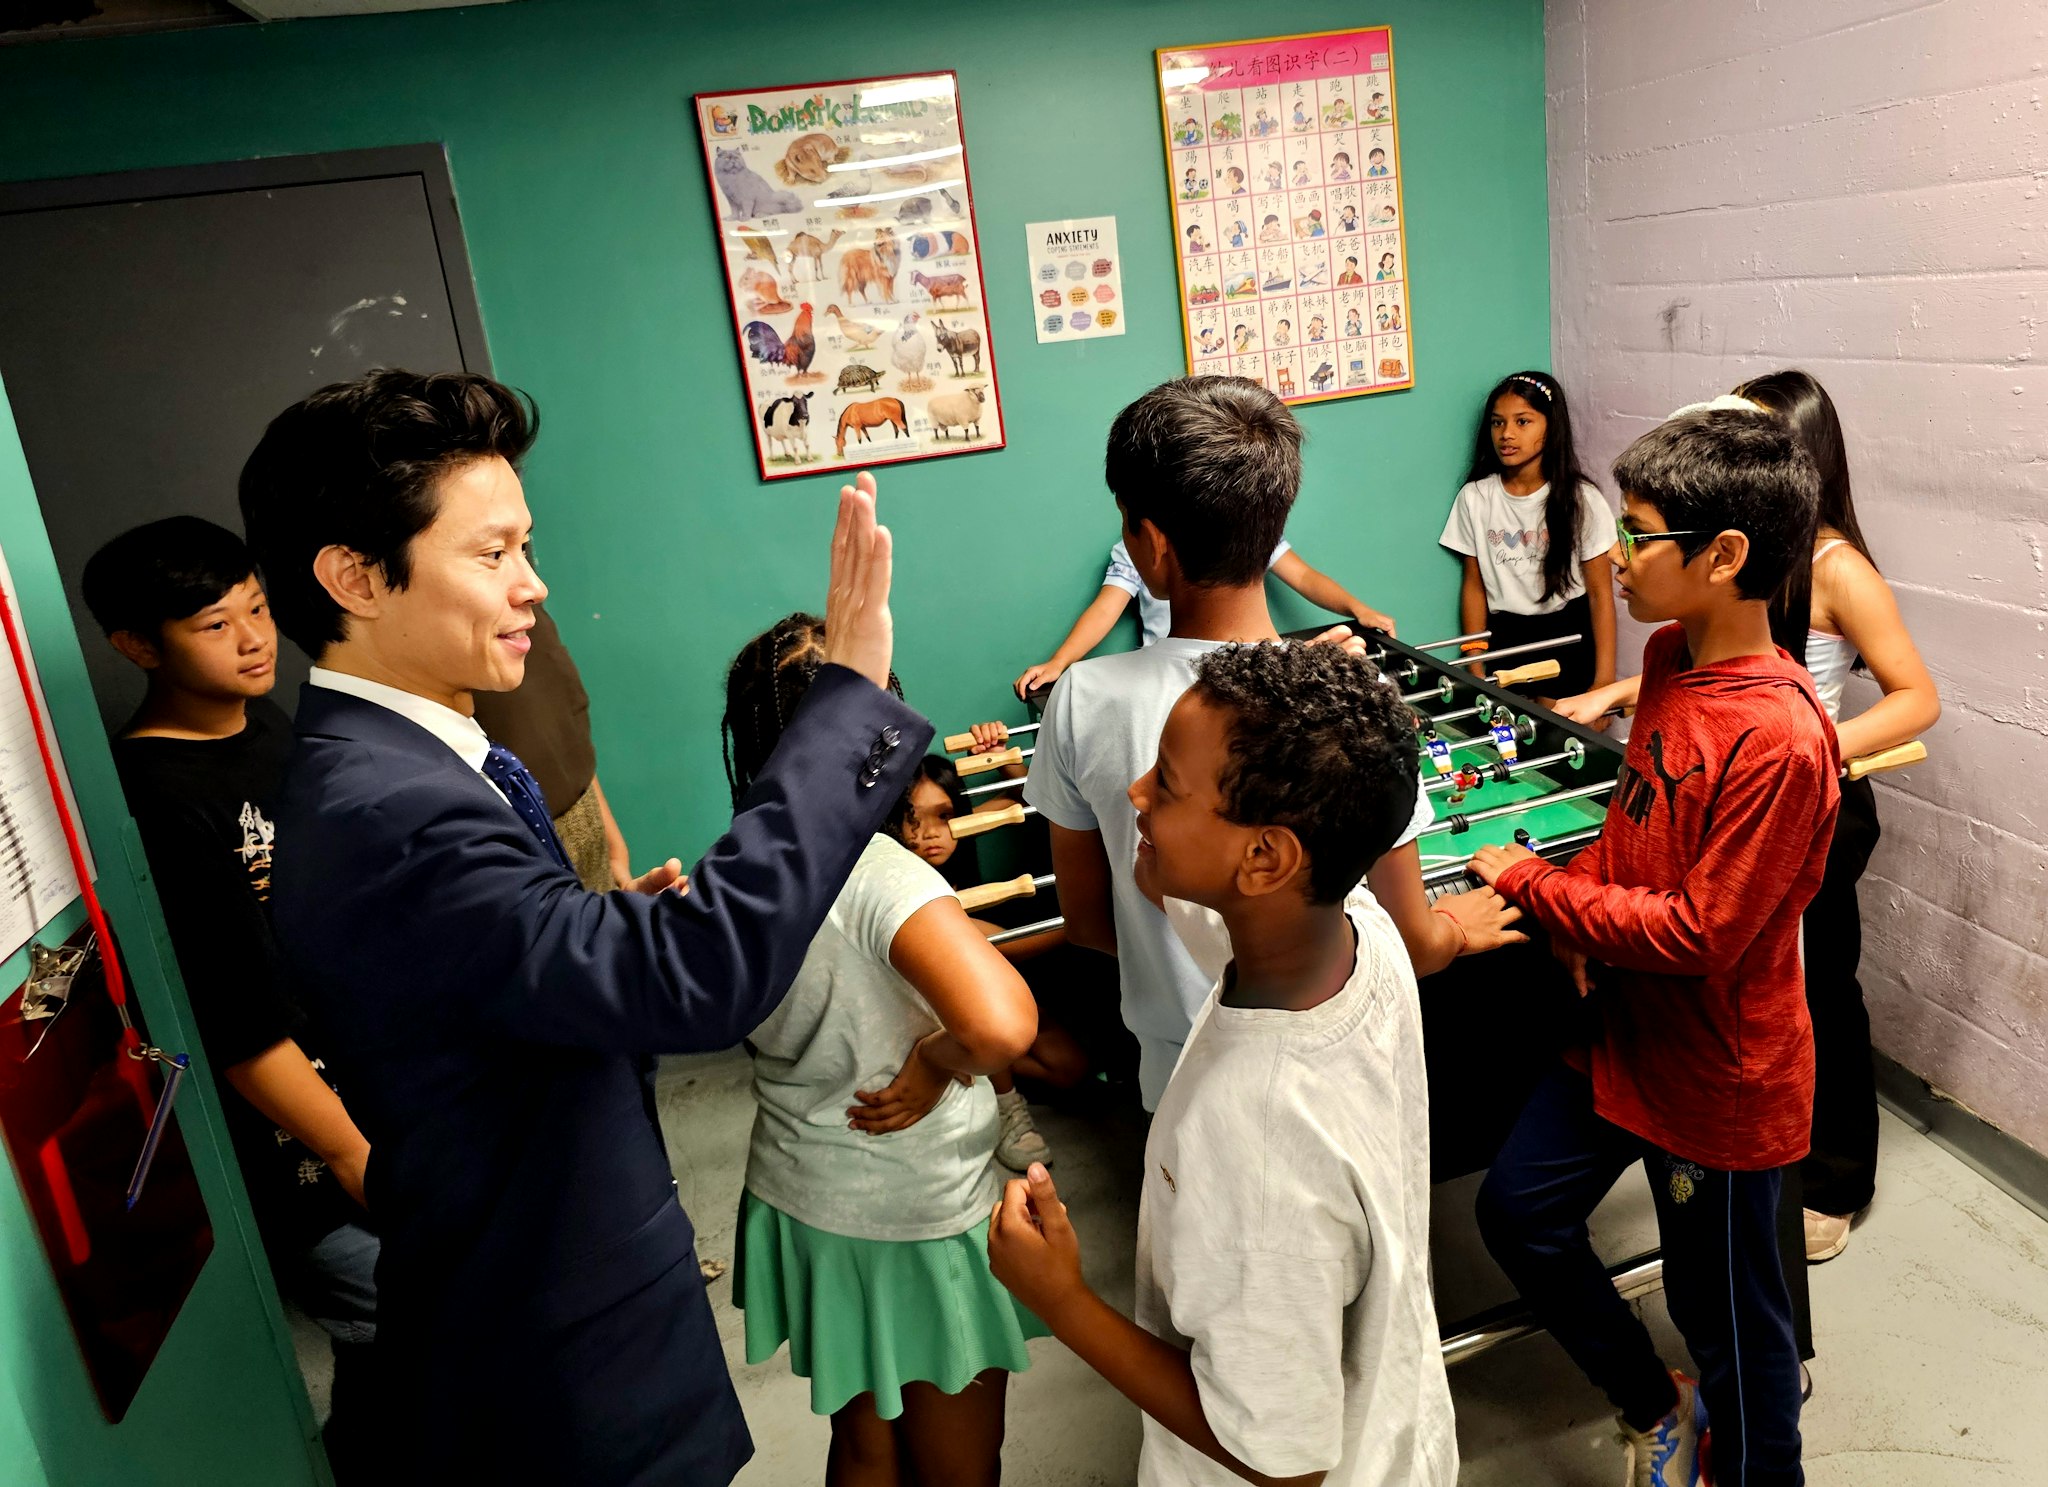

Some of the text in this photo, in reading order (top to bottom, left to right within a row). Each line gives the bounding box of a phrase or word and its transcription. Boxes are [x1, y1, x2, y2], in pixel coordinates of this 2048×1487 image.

[1329, 79, 1342, 92] 跑
[1366, 75, 1379, 87] 跳
[1256, 87, 1267, 100] 站
[1292, 83, 1304, 97] 走
[1180, 96, 1191, 110] 坐
[1217, 91, 1230, 105] 爬
[1334, 132, 1345, 146] 哭
[1370, 129, 1382, 142] 笑
[1223, 146, 1233, 160] 看
[1330, 185, 1357, 201] 唱歌
[1366, 181, 1393, 196] 游泳
[1258, 194, 1283, 209] 写字
[1294, 190, 1320, 204] 画画
[1189, 204, 1203, 218] 吃
[1226, 199, 1239, 213] 喝
[1046, 229, 1098, 246] ANXIETY
[1371, 233, 1396, 247] 妈妈
[1047, 243, 1099, 254] COPING STATEMENTS
[1298, 243, 1325, 256] 飞机
[1335, 237, 1361, 253] 爸爸
[1226, 252, 1252, 267] 火车
[1262, 247, 1289, 261] 轮船
[1188, 256, 1215, 272] 汽车
[1339, 289, 1364, 305] 老师
[1374, 284, 1399, 300] 同学
[1268, 299, 1292, 315] 弟弟
[1302, 293, 1328, 308] 妹妹
[1194, 308, 1220, 324] 哥哥
[1230, 305, 1256, 318] 姐姐
[1342, 340, 1367, 354] 电脑
[1378, 335, 1403, 349] 书包
